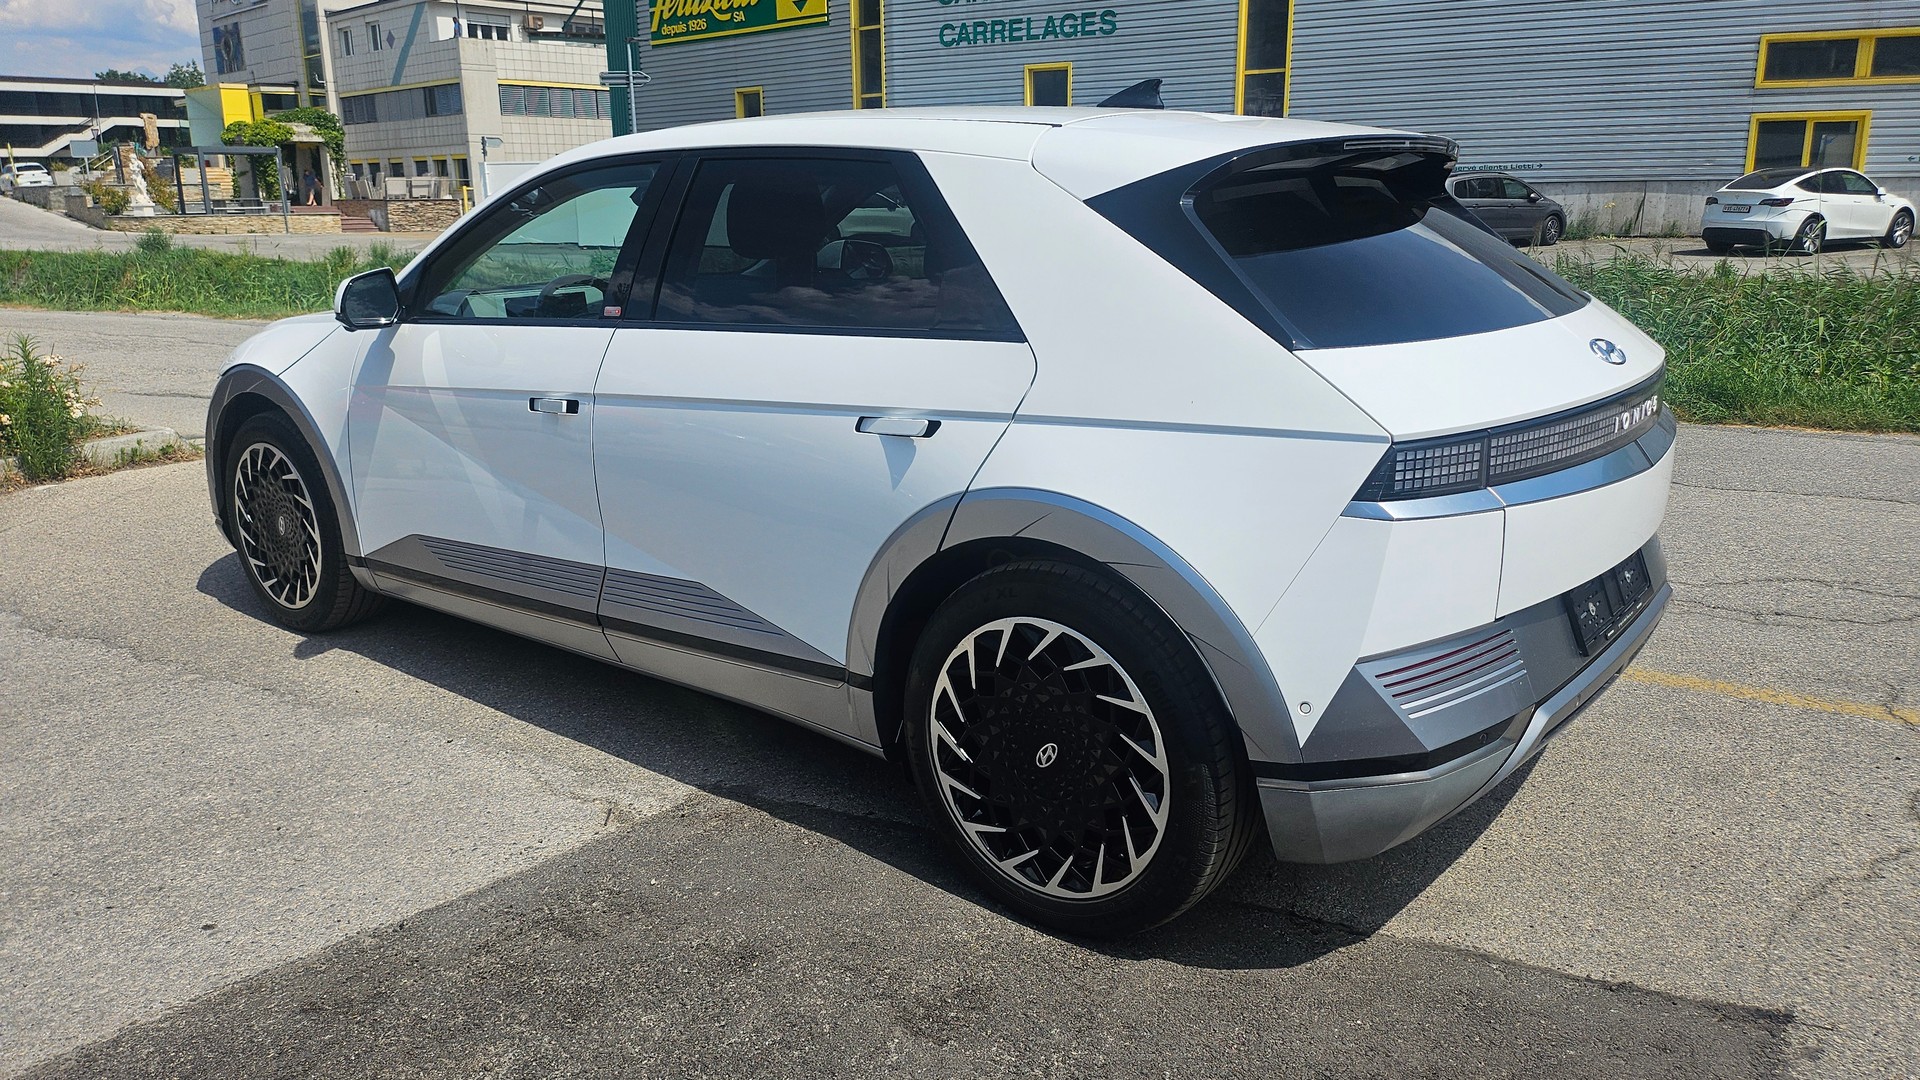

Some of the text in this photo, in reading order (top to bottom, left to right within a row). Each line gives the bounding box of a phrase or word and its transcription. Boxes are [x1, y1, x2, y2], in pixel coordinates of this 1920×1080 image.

[733, 11, 745, 22] SA
[661, 18, 707, 36] depuis 1926
[939, 9, 1117, 47] CARRELAGES
